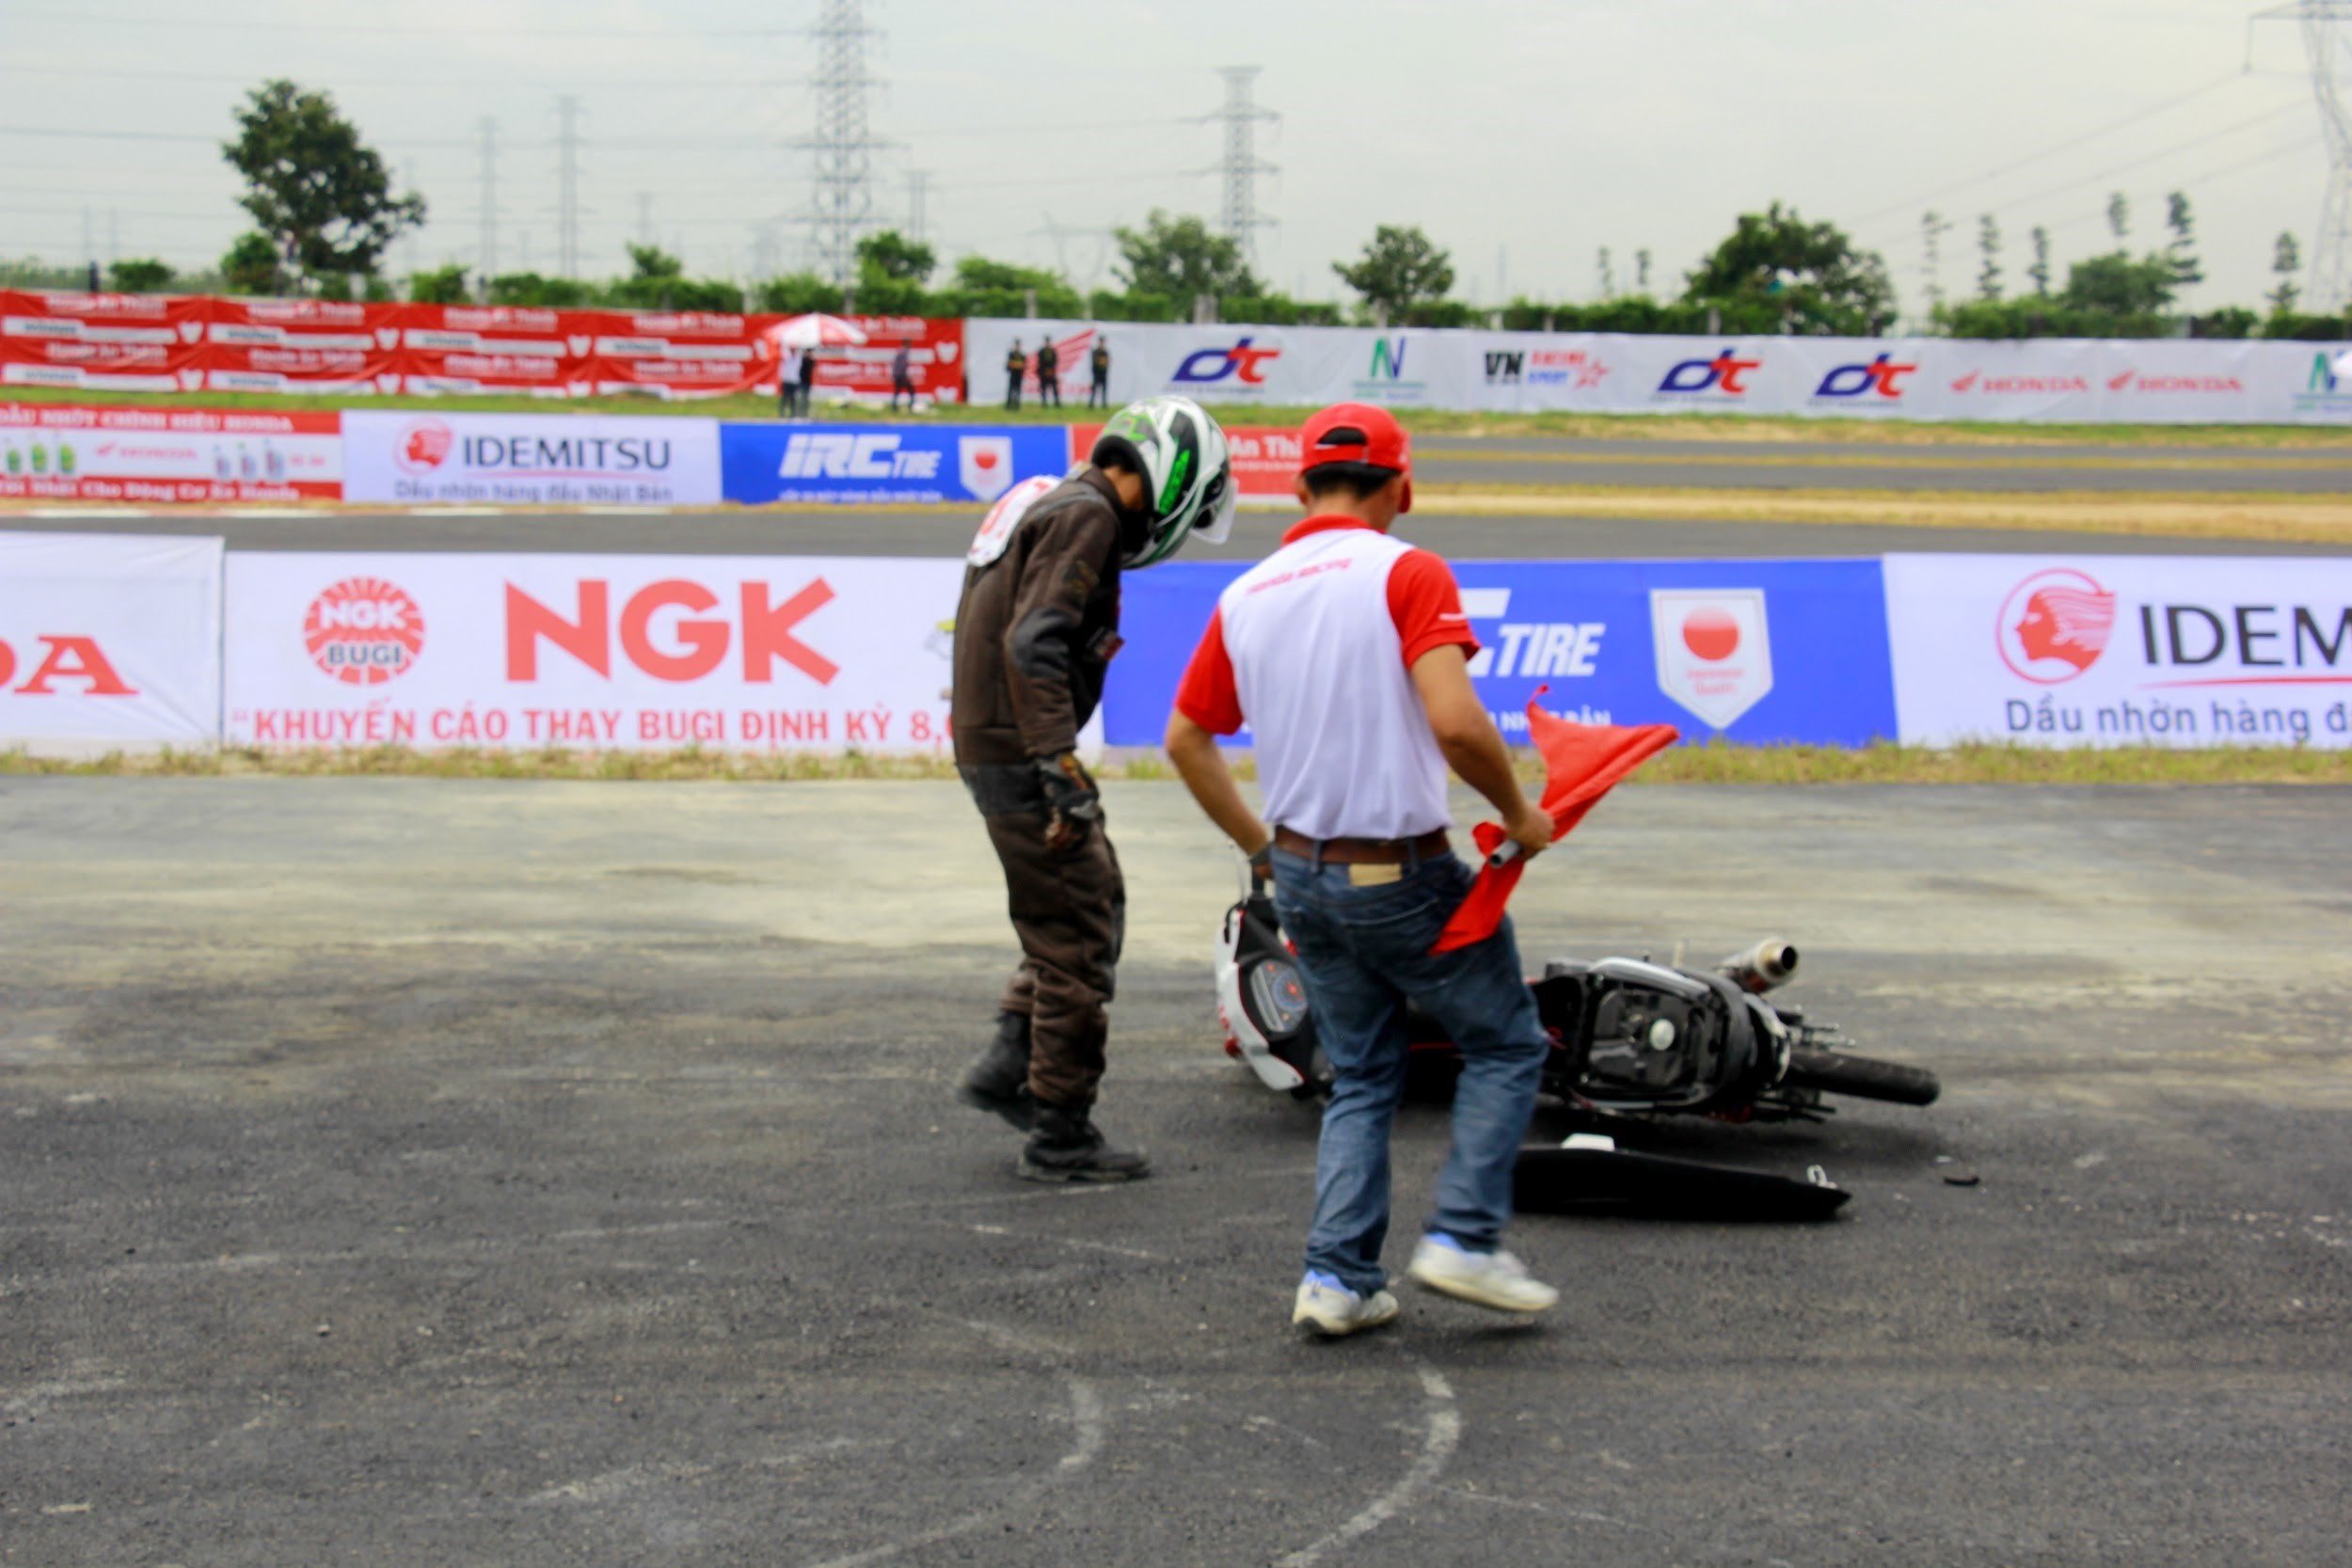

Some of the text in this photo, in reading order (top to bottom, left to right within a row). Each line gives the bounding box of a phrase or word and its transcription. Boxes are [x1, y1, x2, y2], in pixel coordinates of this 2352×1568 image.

[1982, 377, 2089, 393] HONDA
[2136, 377, 2243, 392] HONDA
[464, 436, 671, 470] IDEMITSU
[779, 434, 901, 478] IRC
[319, 598, 407, 630] NGK
[504, 577, 840, 687] NGK
[328, 644, 401, 665] BUGI
[1496, 623, 1606, 677] TIRE
[431, 700, 508, 741] CÁO
[522, 709, 621, 741] THAY
[639, 709, 725, 741] BUGI
[740, 709, 829, 748] ĐỊNH
[2006, 691, 2352, 740] Dầu nhờn hàng đ
